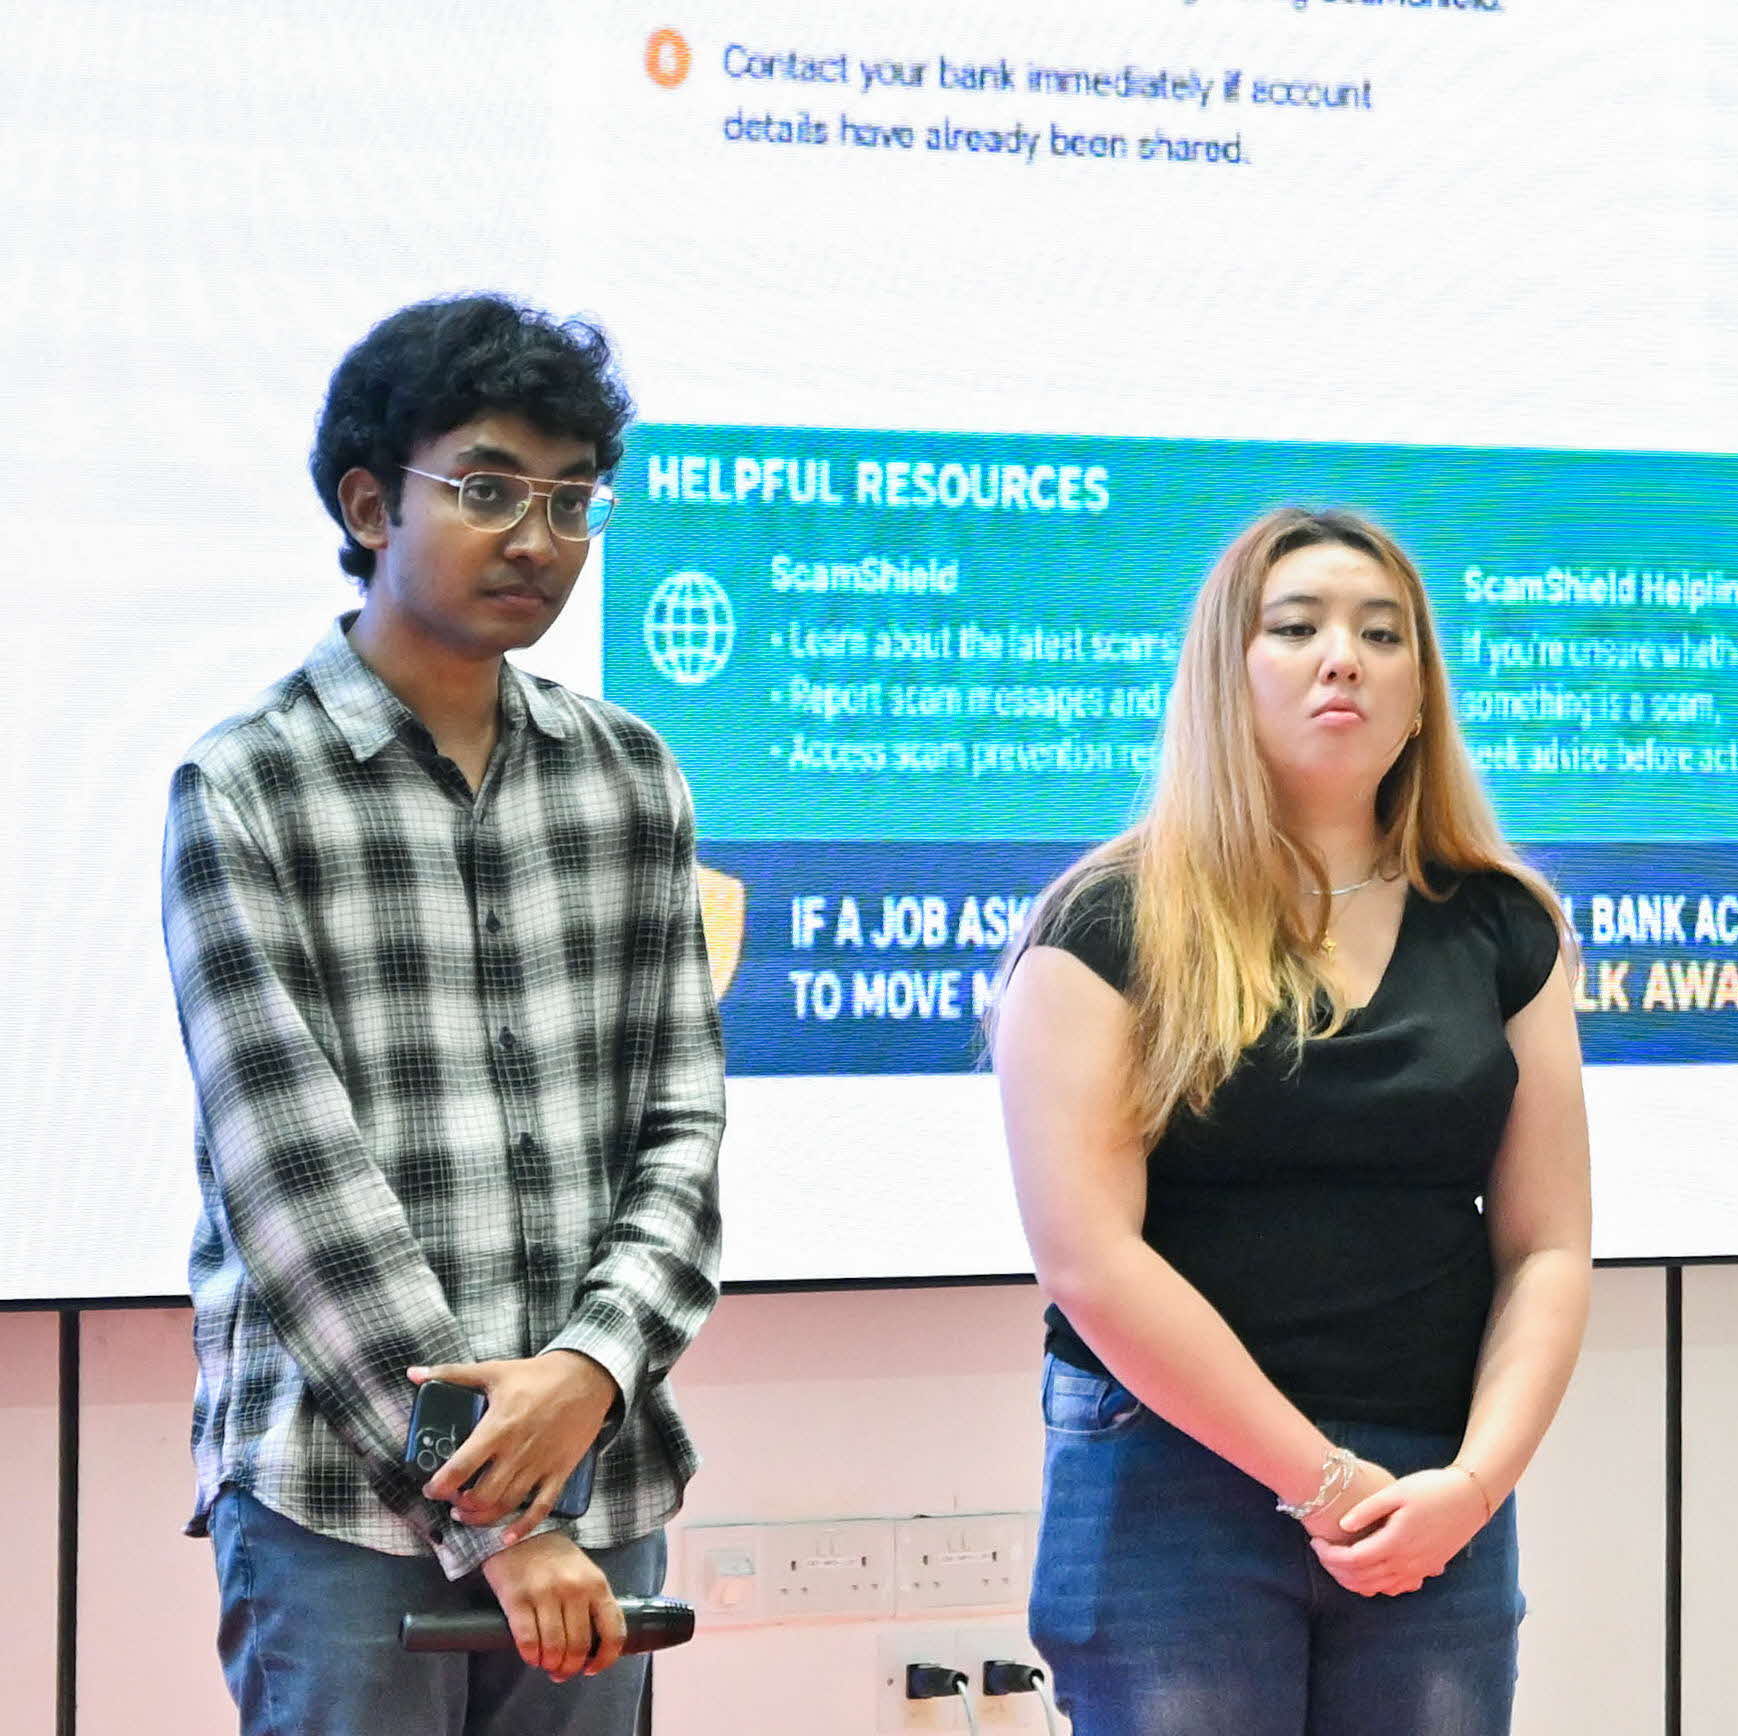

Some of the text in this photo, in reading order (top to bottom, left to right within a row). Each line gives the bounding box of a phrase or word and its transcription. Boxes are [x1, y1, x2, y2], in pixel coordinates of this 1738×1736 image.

[723, 42, 1373, 110] Contact your bank immediately if account
[723, 107, 828, 146] details
[841, 113, 915, 150] have
[927, 116, 1041, 164] already
[1050, 122, 1128, 159] been
[647, 453, 1111, 512] HELPFUL RESOURCES
[770, 555, 960, 597] ScamShield
[1464, 565, 1637, 606] ScamShield
[788, 622, 868, 660] Learn
[875, 624, 952, 660] about
[959, 622, 1001, 660] the
[1008, 625, 1083, 663] latest
[1461, 628, 1482, 665] If
[1569, 639, 1651, 670] unsure
[788, 674, 1162, 726] Report scam messages and
[1602, 686, 1622, 722] is
[788, 734, 887, 772] Access
[897, 741, 966, 772] scam
[971, 737, 1112, 778] prevention
[1534, 737, 1611, 774] advice
[1617, 737, 1693, 774] before
[790, 895, 828, 948] IF
[834, 896, 866, 948] A
[870, 896, 948, 949] JOB
[1591, 894, 1688, 944] BANK
[788, 969, 843, 1020] TO
[852, 970, 963, 1020] MOVE
[1573, 960, 1631, 1013] LK
